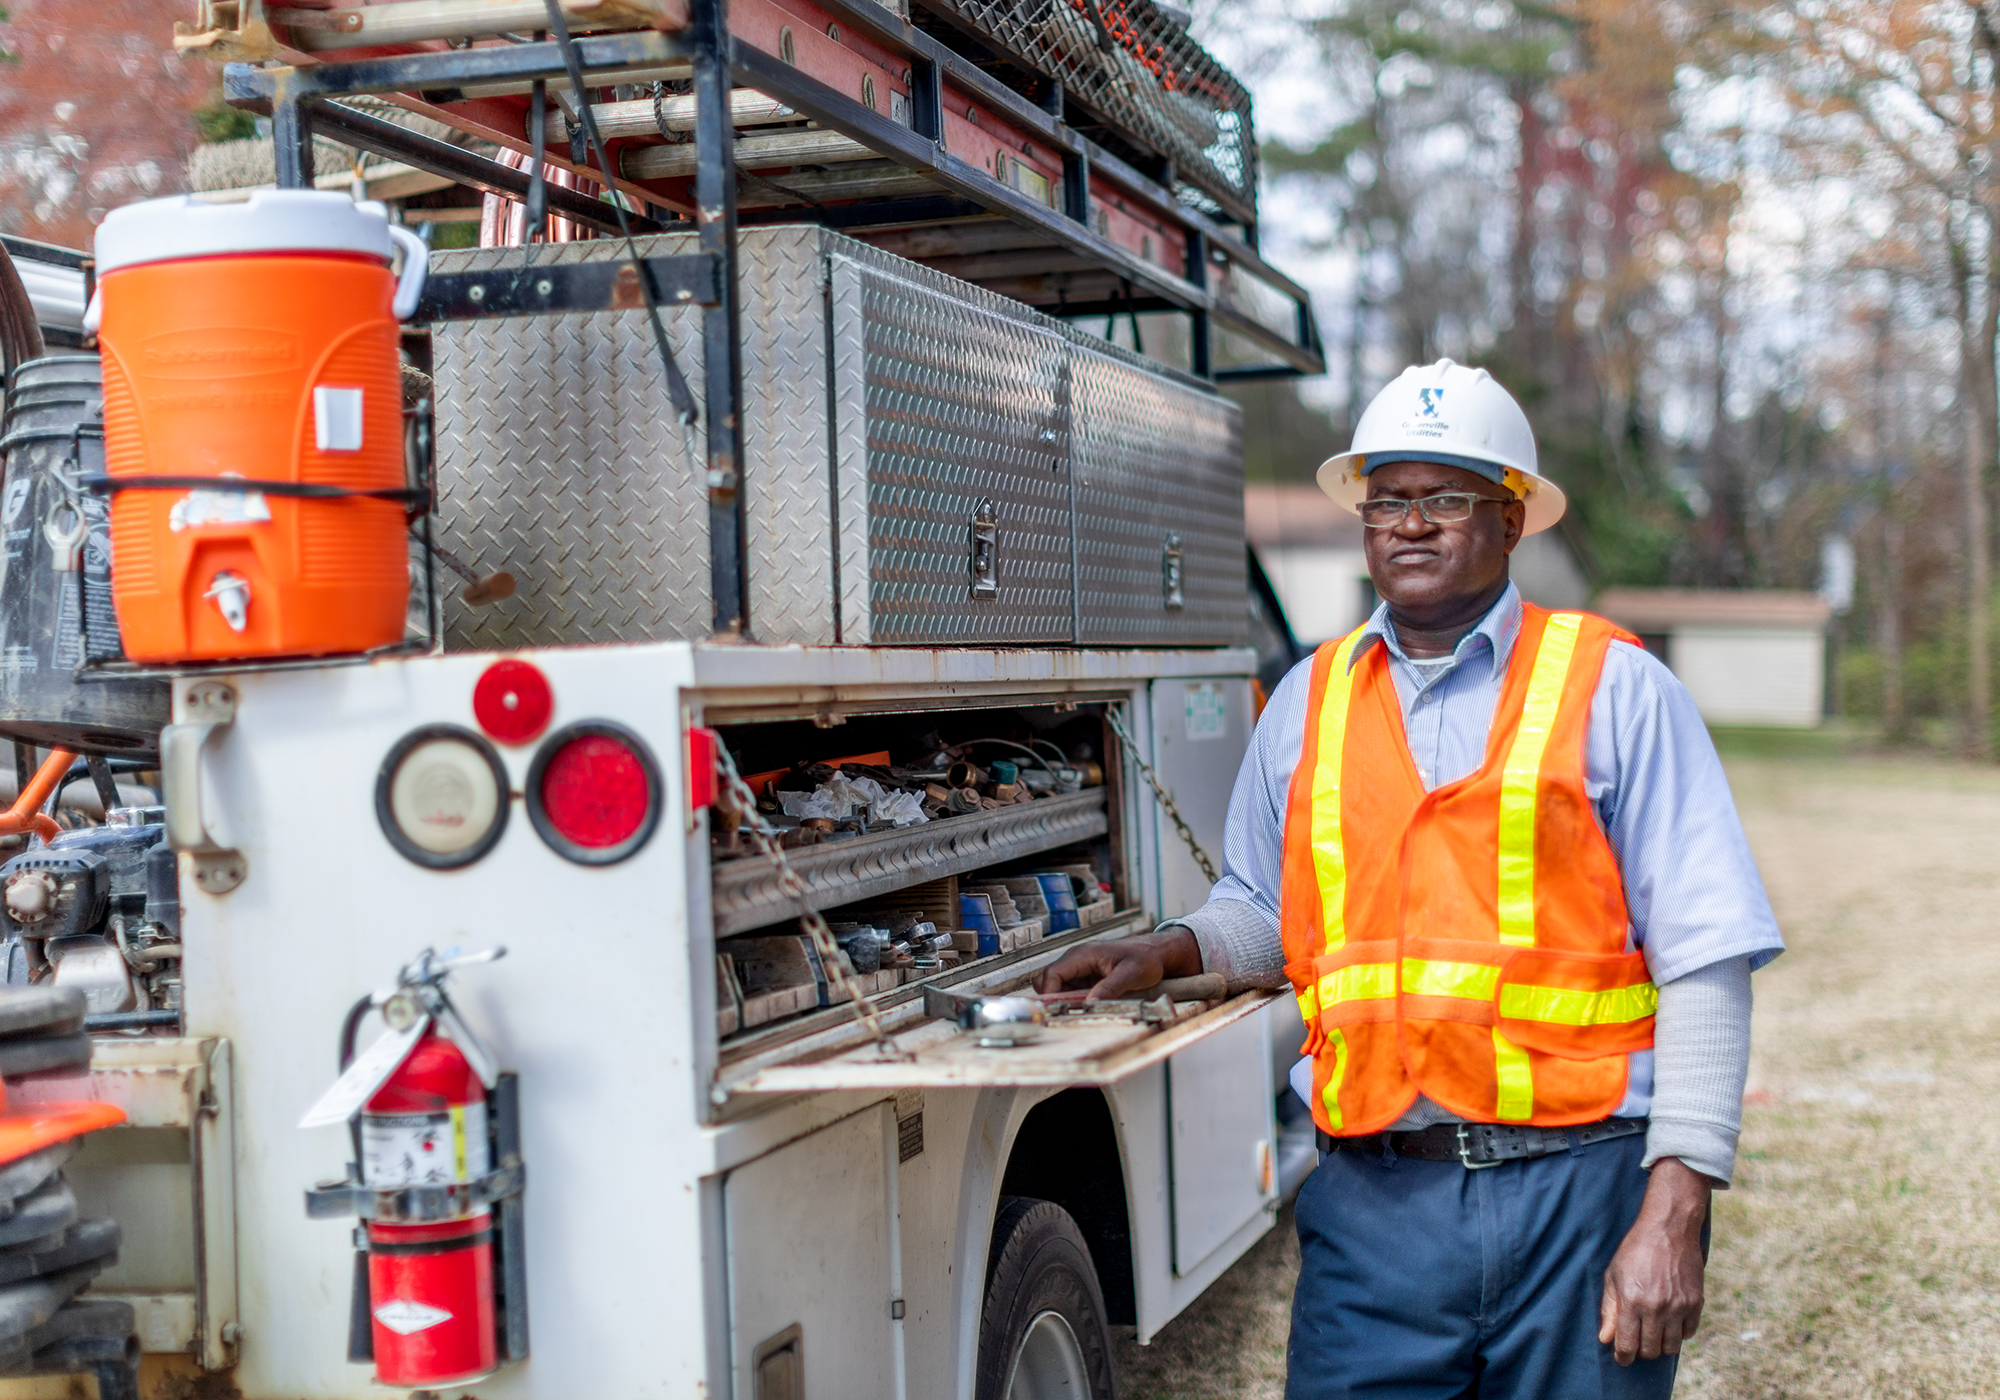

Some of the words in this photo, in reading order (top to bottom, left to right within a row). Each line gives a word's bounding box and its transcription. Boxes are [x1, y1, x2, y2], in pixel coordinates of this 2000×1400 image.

[144, 341, 293, 367] Rubbermaid
[1402, 421, 1449, 431] Genville
[1406, 430, 1442, 438] Utilities
